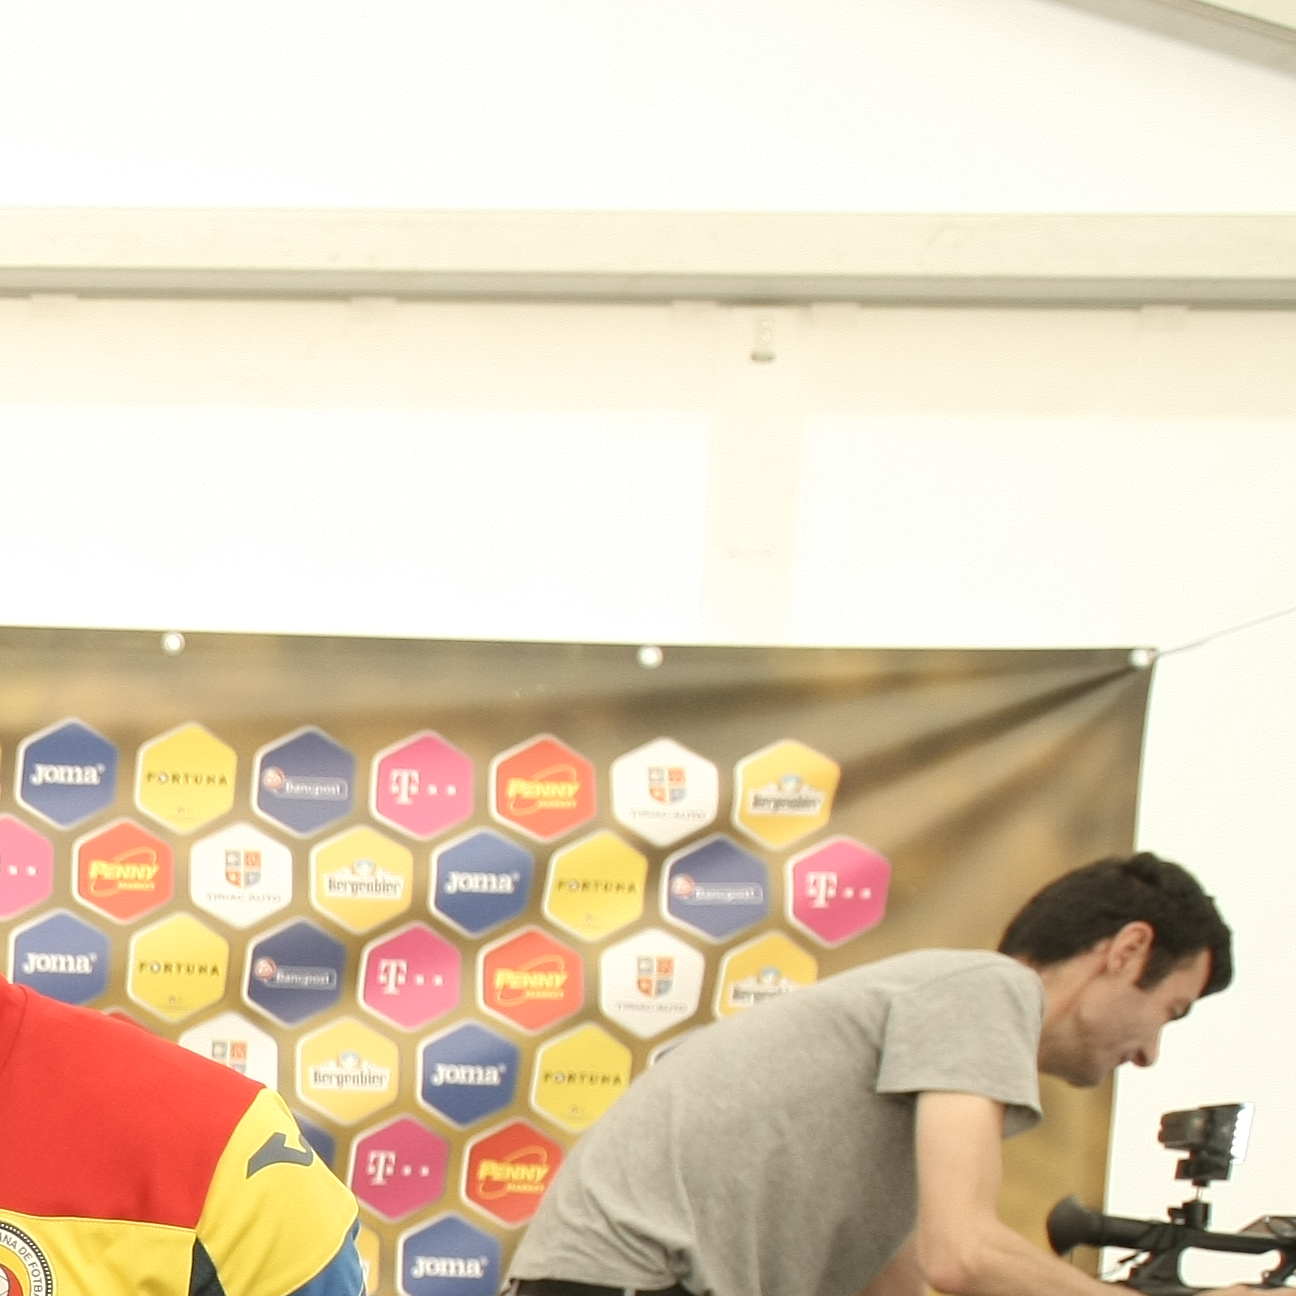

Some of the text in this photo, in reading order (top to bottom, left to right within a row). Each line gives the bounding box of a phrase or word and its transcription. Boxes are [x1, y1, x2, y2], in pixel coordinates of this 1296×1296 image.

[29, 763, 100, 786] Joma
[444, 871, 514, 894] Joma
[22, 952, 92, 975] Joma
[430, 1063, 500, 1086] Joma
[411, 1256, 484, 1279] Joma
